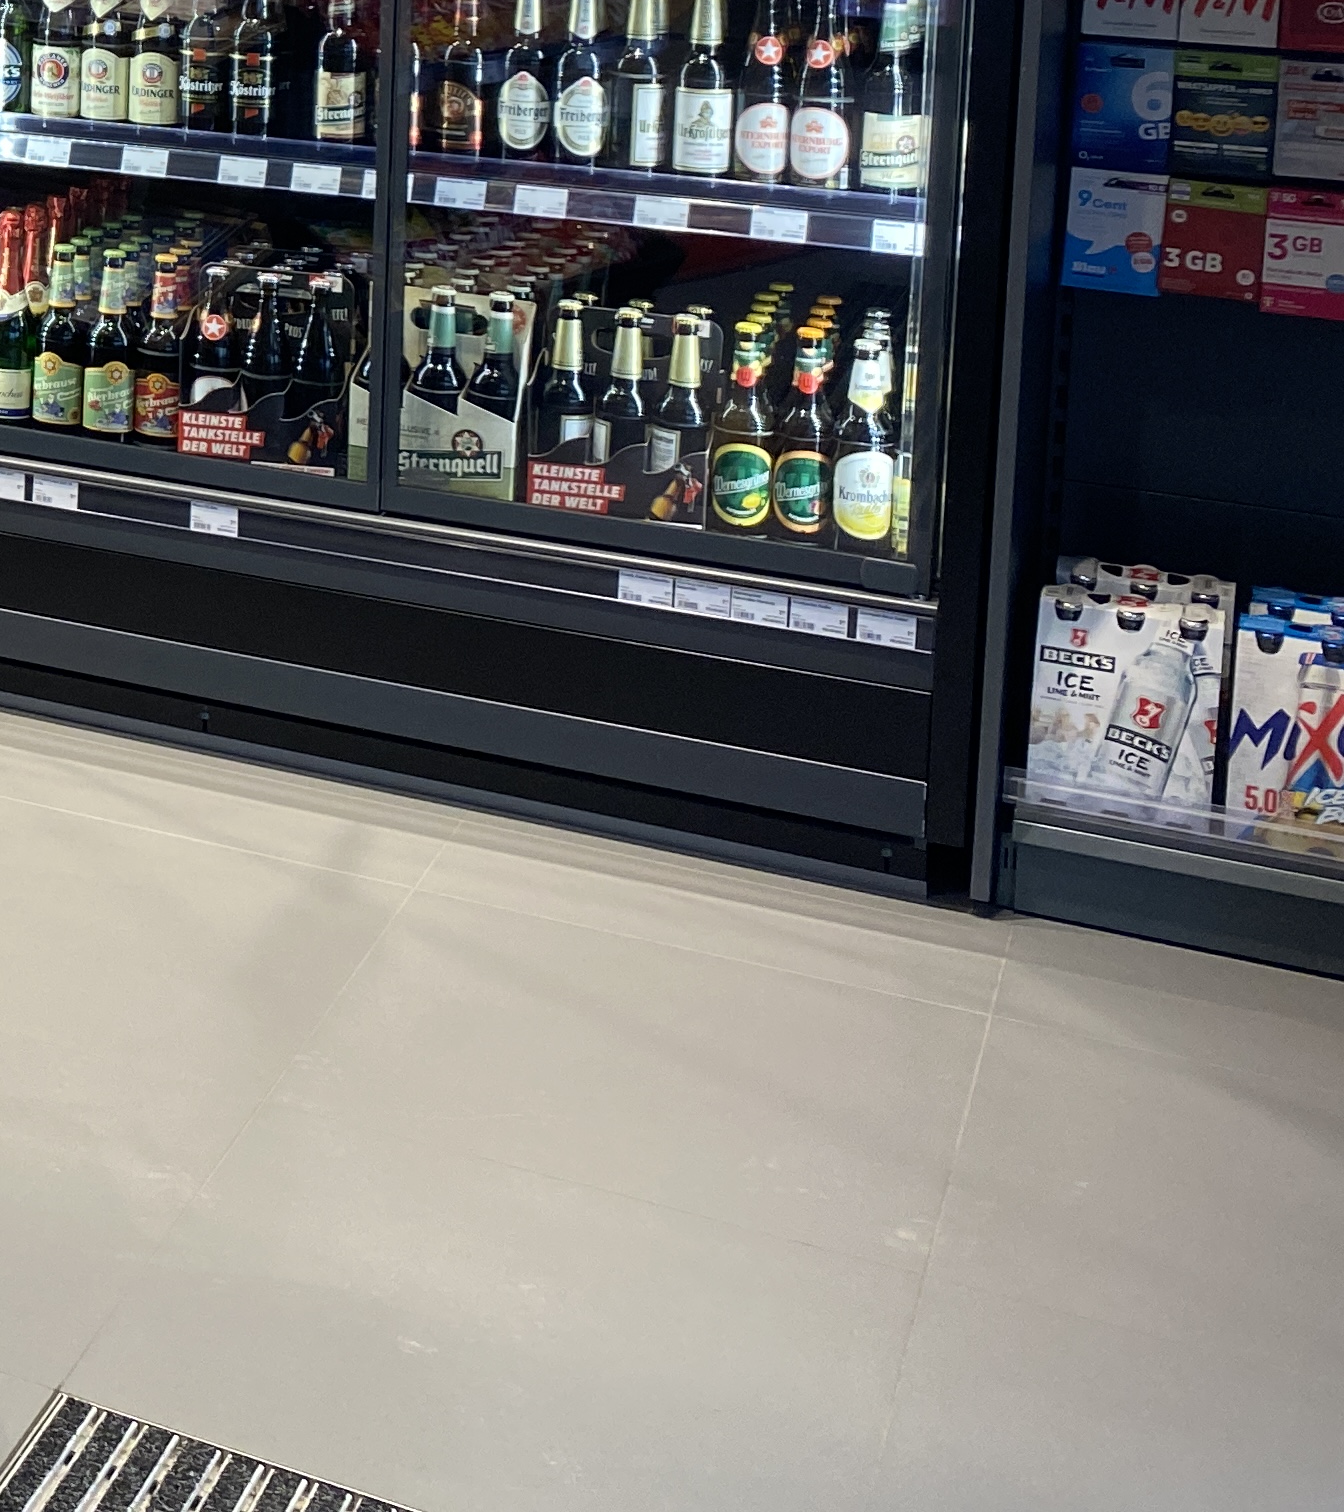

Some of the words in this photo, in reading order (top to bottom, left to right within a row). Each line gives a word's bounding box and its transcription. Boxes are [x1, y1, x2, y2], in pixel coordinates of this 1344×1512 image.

[1132, 71, 1171, 121] 6
[1078, 189, 1092, 208] 9
[1093, 198, 1127, 211] Cent
[1267, 233, 1288, 260] 3
[1292, 236, 1322, 253] GB
[1164, 248, 1181, 267] 3
[1185, 251, 1222, 272] GB
[182, 413, 244, 429] KLEINSTE
[183, 427, 262, 444] TANKSTELLE
[182, 440, 208, 454] DER
[212, 442, 247, 458] WELT
[398, 451, 499, 477] Sternquell
[533, 464, 602, 481] KLEINSTE
[533, 478, 620, 498] TANKSTELLE
[531, 491, 560, 507] DER
[566, 495, 604, 511] WELT
[1042, 648, 1114, 671] BECK'S
[1057, 671, 1094, 692] ICE
[1108, 727, 1170, 760] BECK'S
[1118, 749, 1150, 770] ICE
